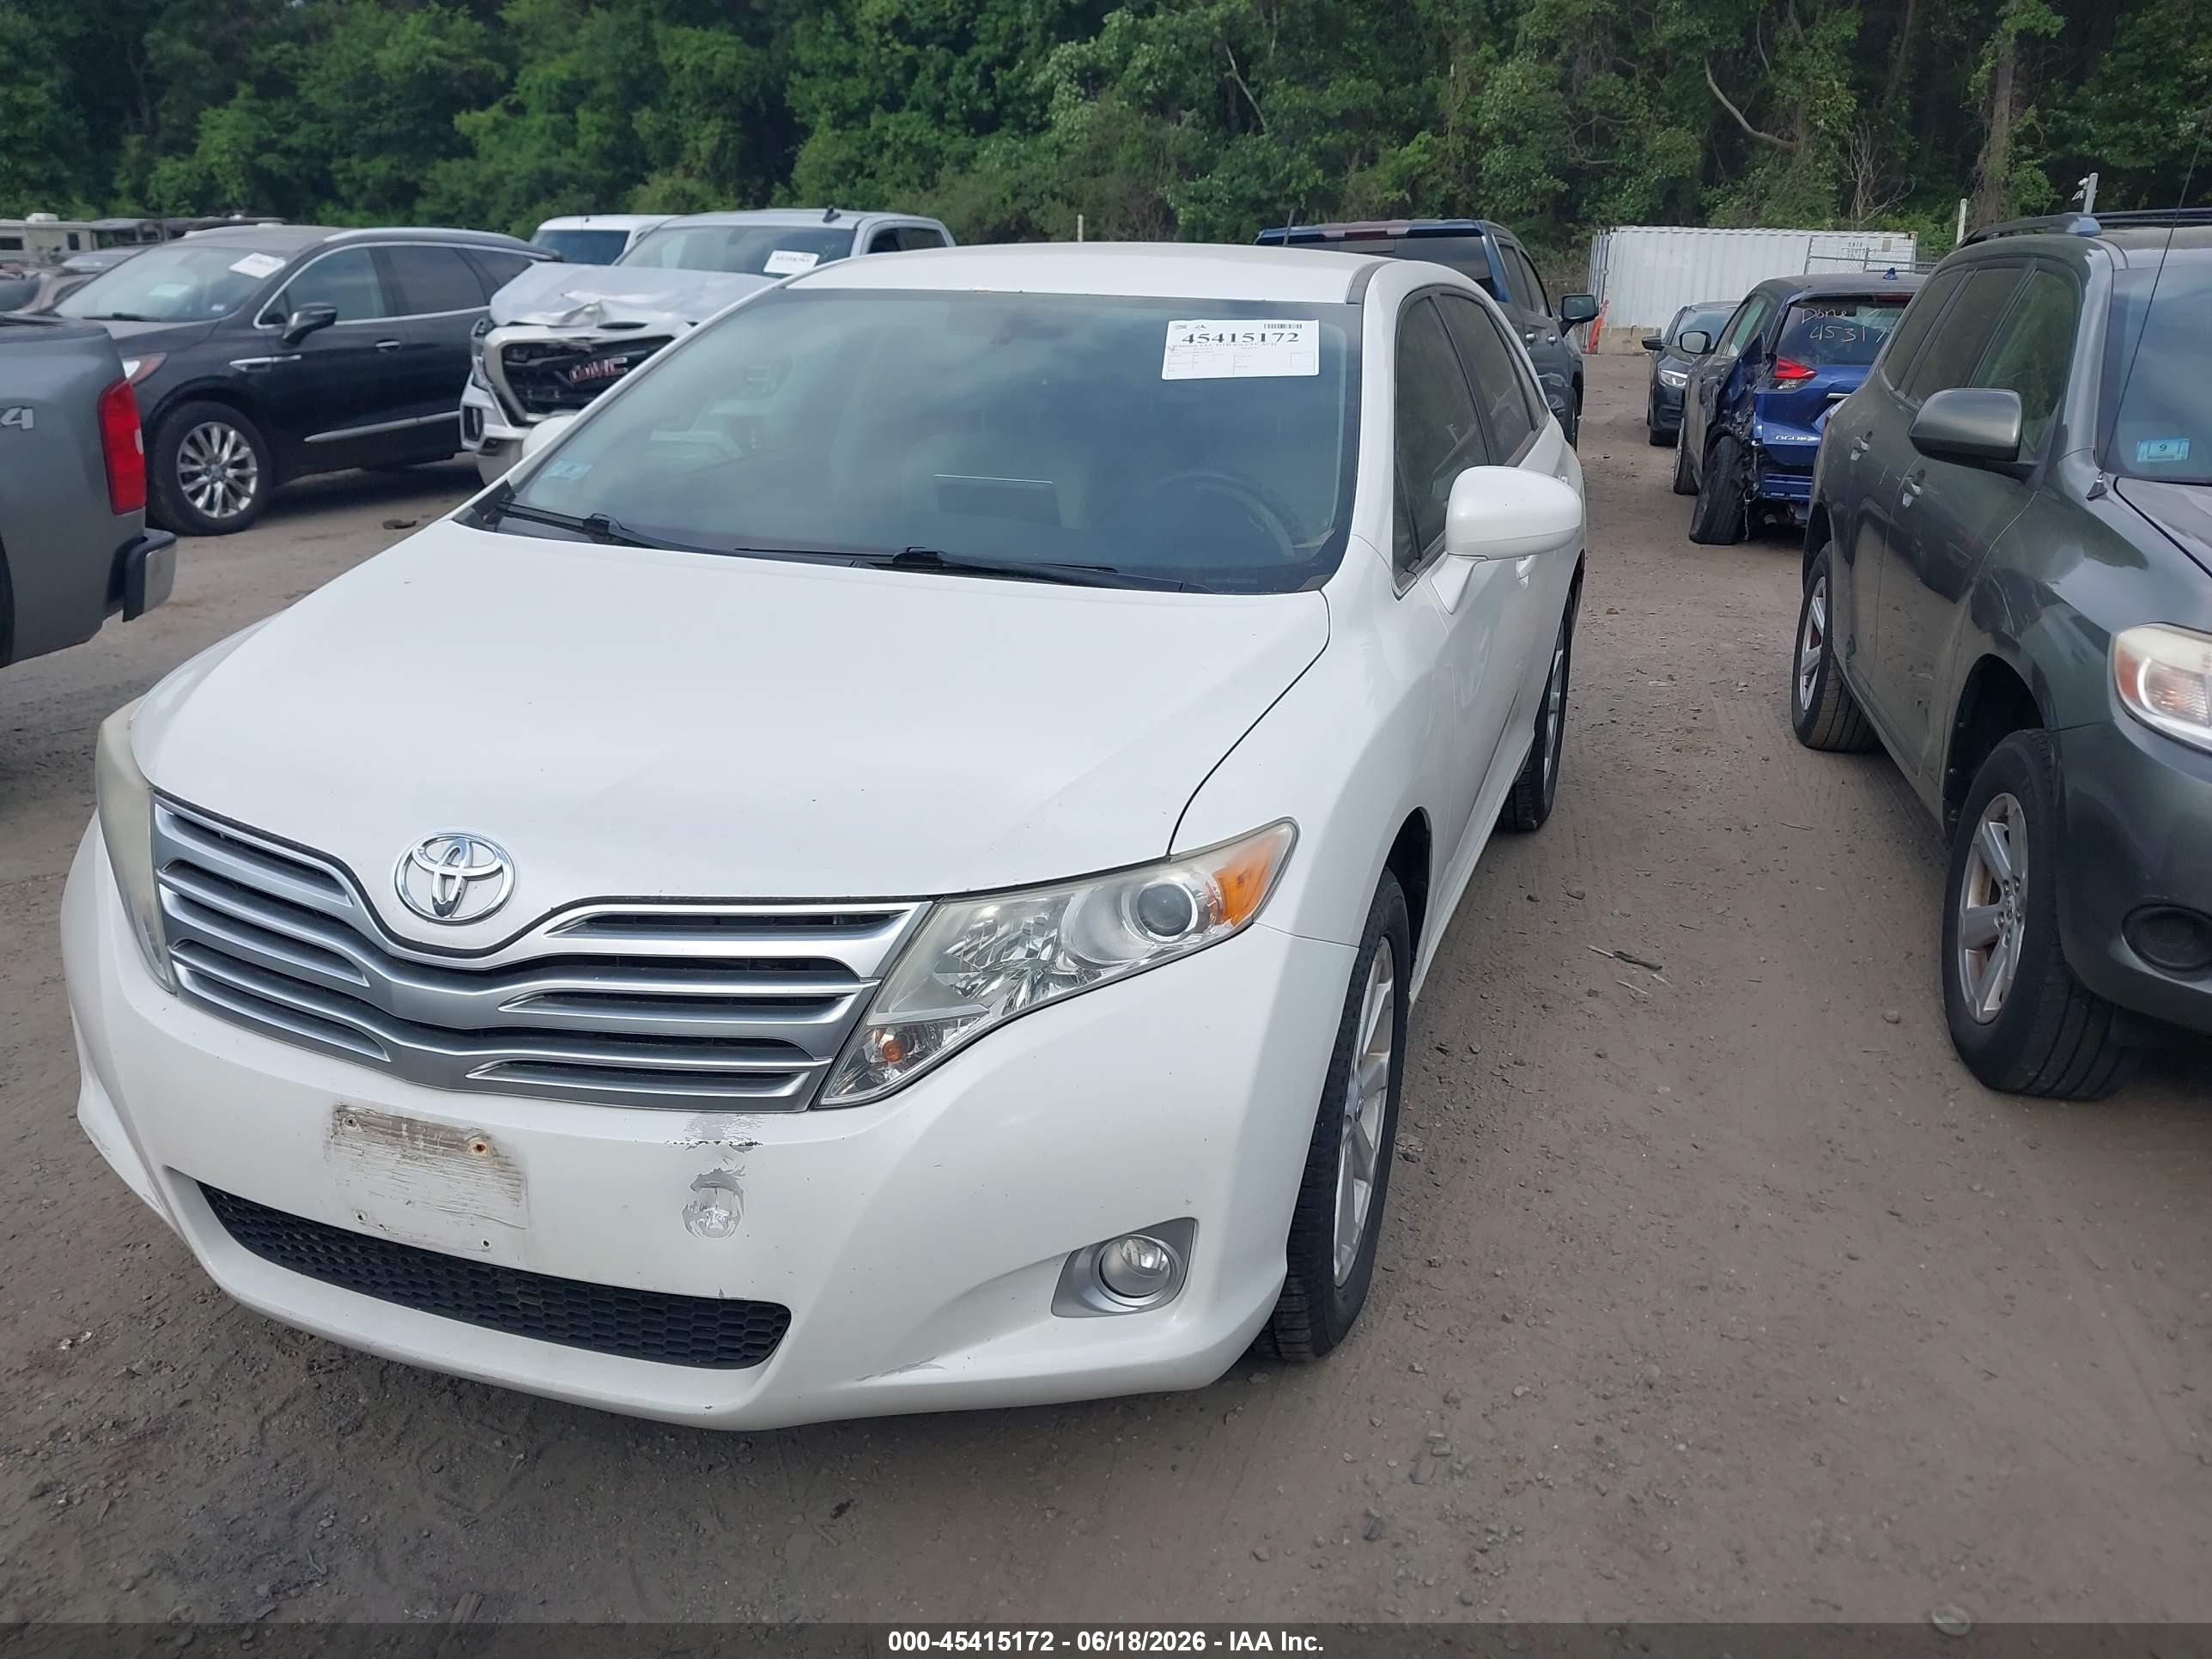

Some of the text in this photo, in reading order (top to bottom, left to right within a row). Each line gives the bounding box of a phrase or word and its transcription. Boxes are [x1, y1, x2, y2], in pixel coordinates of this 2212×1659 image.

[1801, 307, 1847, 325] Done
[1182, 332, 1299, 344] 45415172
[1809, 324, 1894, 343] 45317
[0, 407, 34, 429] 4
